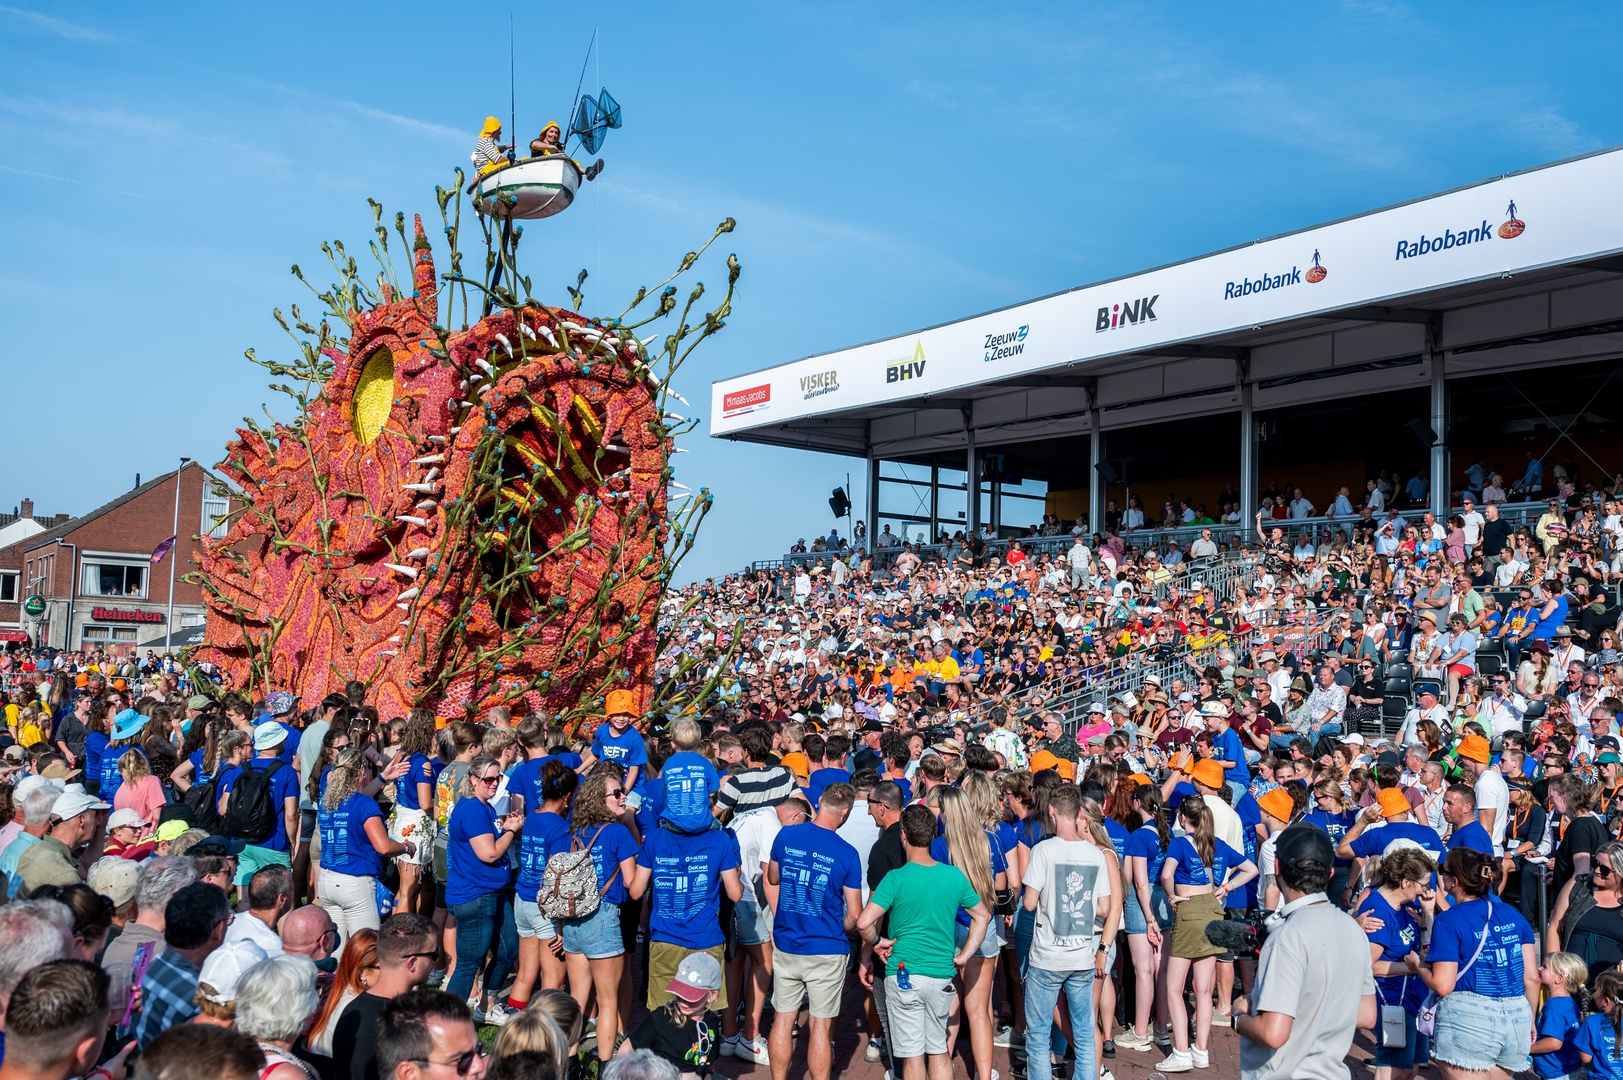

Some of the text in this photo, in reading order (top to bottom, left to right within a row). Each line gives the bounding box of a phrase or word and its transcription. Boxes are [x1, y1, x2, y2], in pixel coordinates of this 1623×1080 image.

[1396, 220, 1493, 260] Rabobank
[1225, 266, 1301, 300] Rabobank
[984, 334, 1018, 348] Zeeuw
[800, 370, 837, 391] VISKER
[887, 360, 926, 383] BHV
[93, 606, 162, 622] Heineken
